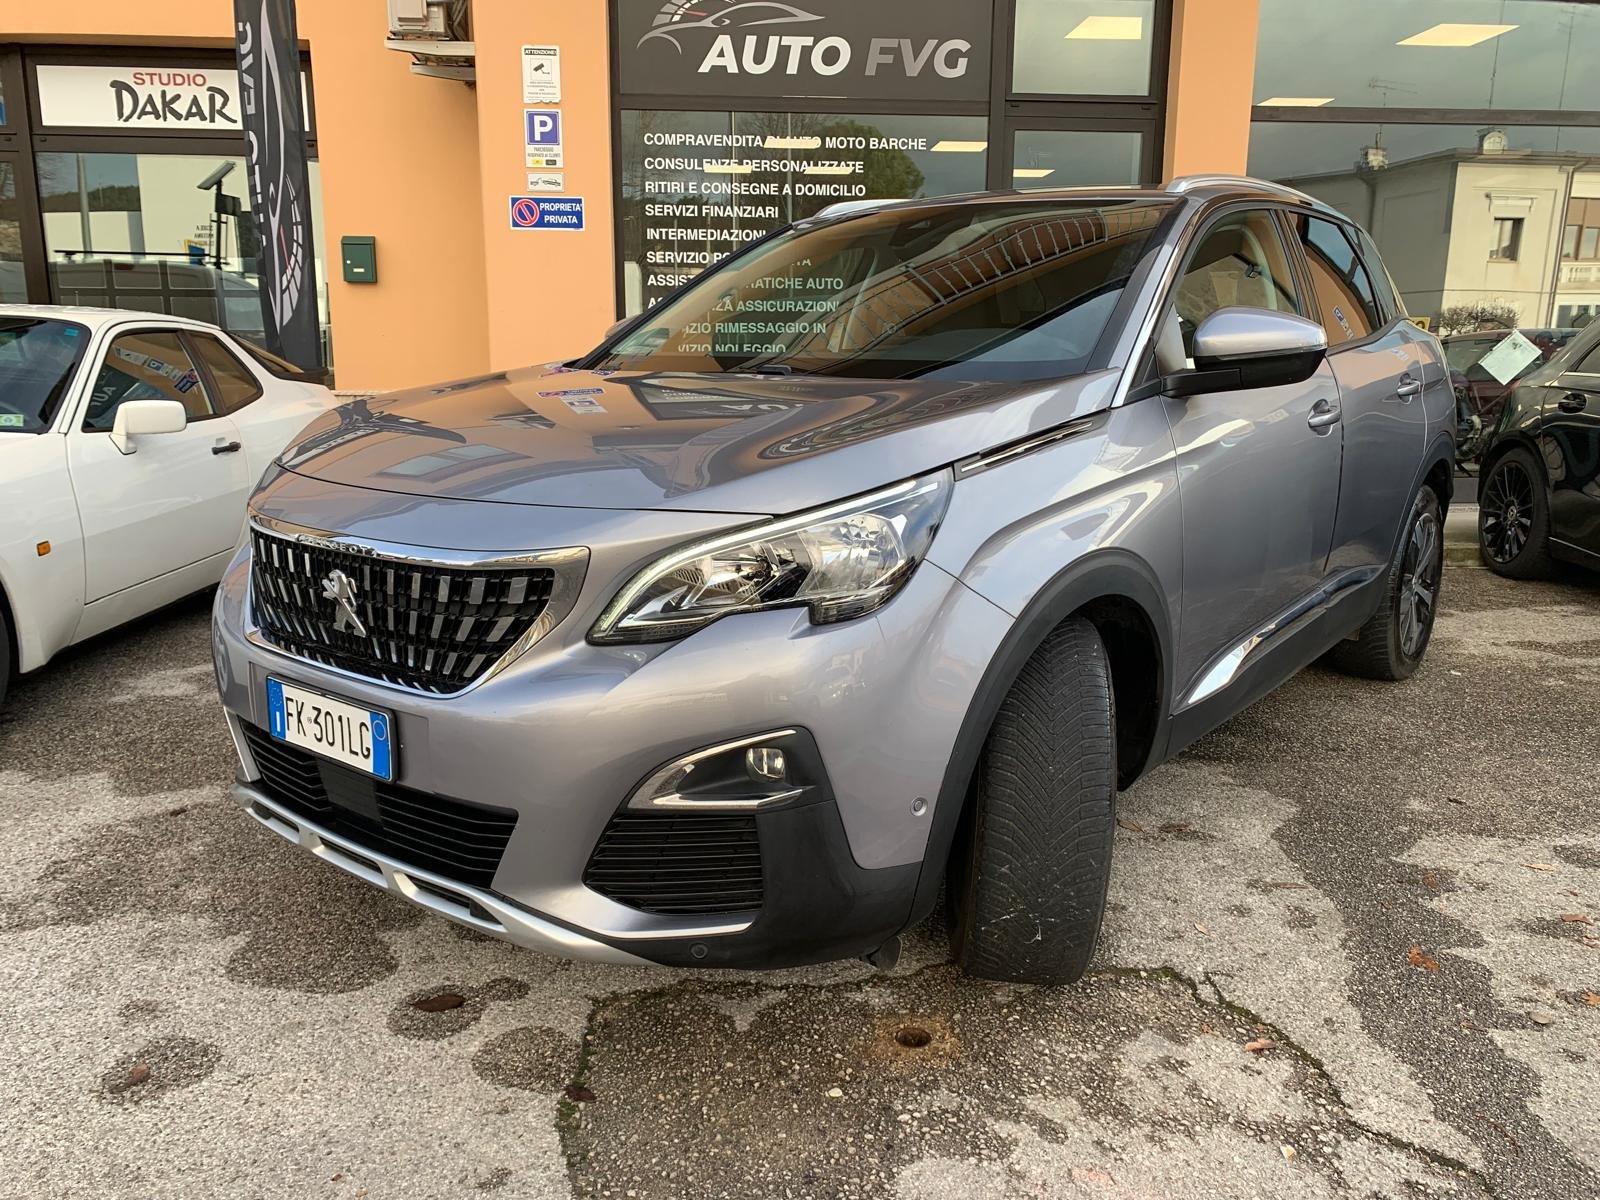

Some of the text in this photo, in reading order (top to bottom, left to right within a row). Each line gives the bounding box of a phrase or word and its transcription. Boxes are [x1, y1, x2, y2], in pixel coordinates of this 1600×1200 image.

[697, 34, 972, 79] AUTO FVG
[133, 72, 207, 87] STUDIO
[109, 79, 238, 123] DAKAR
[533, 115, 553, 141] P
[643, 132, 763, 147] COMPRAVENDITA
[825, 136, 866, 149] MOTO
[869, 137, 927, 150] BARCHE
[644, 157, 738, 171] CONSULENZE
[645, 181, 866, 197] RITIRI E CONSEGNE A DOMICILIO
[645, 204, 779, 218] SERVIZI FINANZIARI
[544, 215, 578, 224] PRIVATA
[646, 251, 709, 264] SERVIZIO
[806, 277, 844, 290] AUTO
[715, 322, 810, 334] RIMESSAGGIO
[813, 322, 826, 334] IN
[285, 697, 307, 737] FK
[312, 705, 371, 760] 301LG
